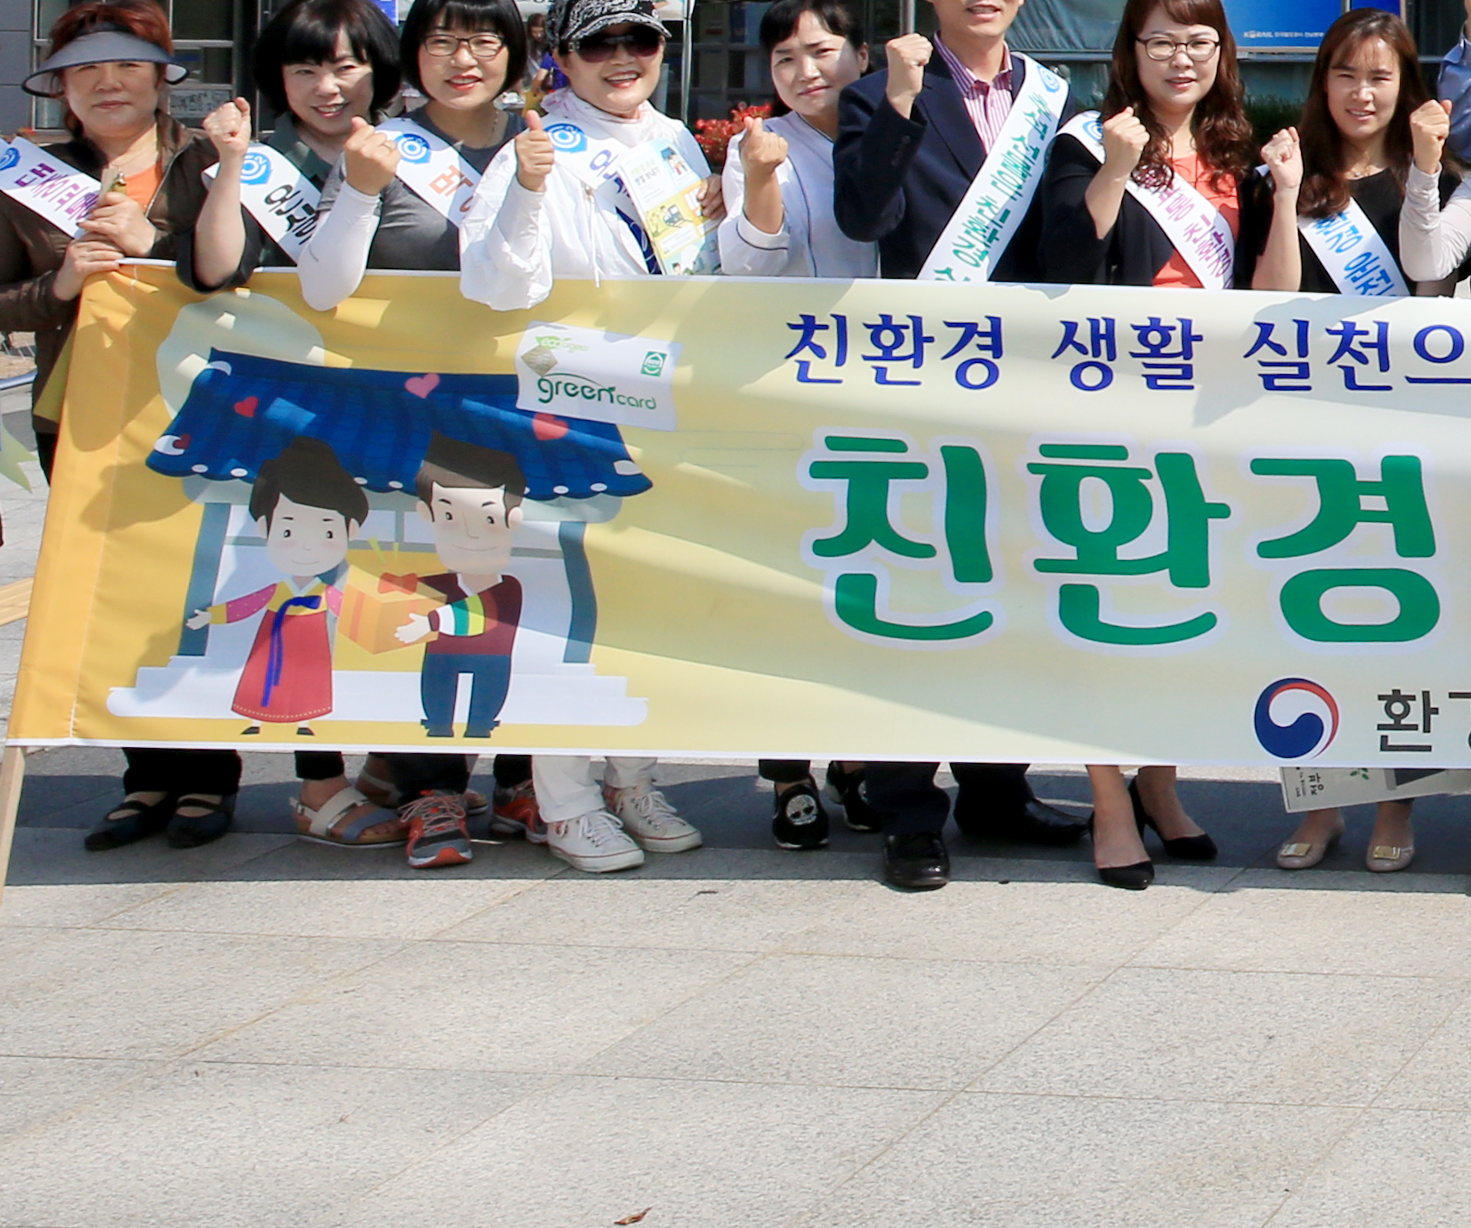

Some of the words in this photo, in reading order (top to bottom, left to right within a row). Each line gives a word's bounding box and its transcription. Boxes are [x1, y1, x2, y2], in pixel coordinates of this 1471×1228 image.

[1024, 92, 1054, 141] 추석
[952, 196, 1012, 268] 친환경
[791, 315, 1002, 389] 친환경
[1055, 318, 1201, 391] 생활
[537, 376, 616, 404] green
[616, 394, 657, 410] card
[809, 437, 1440, 645] 친환경
